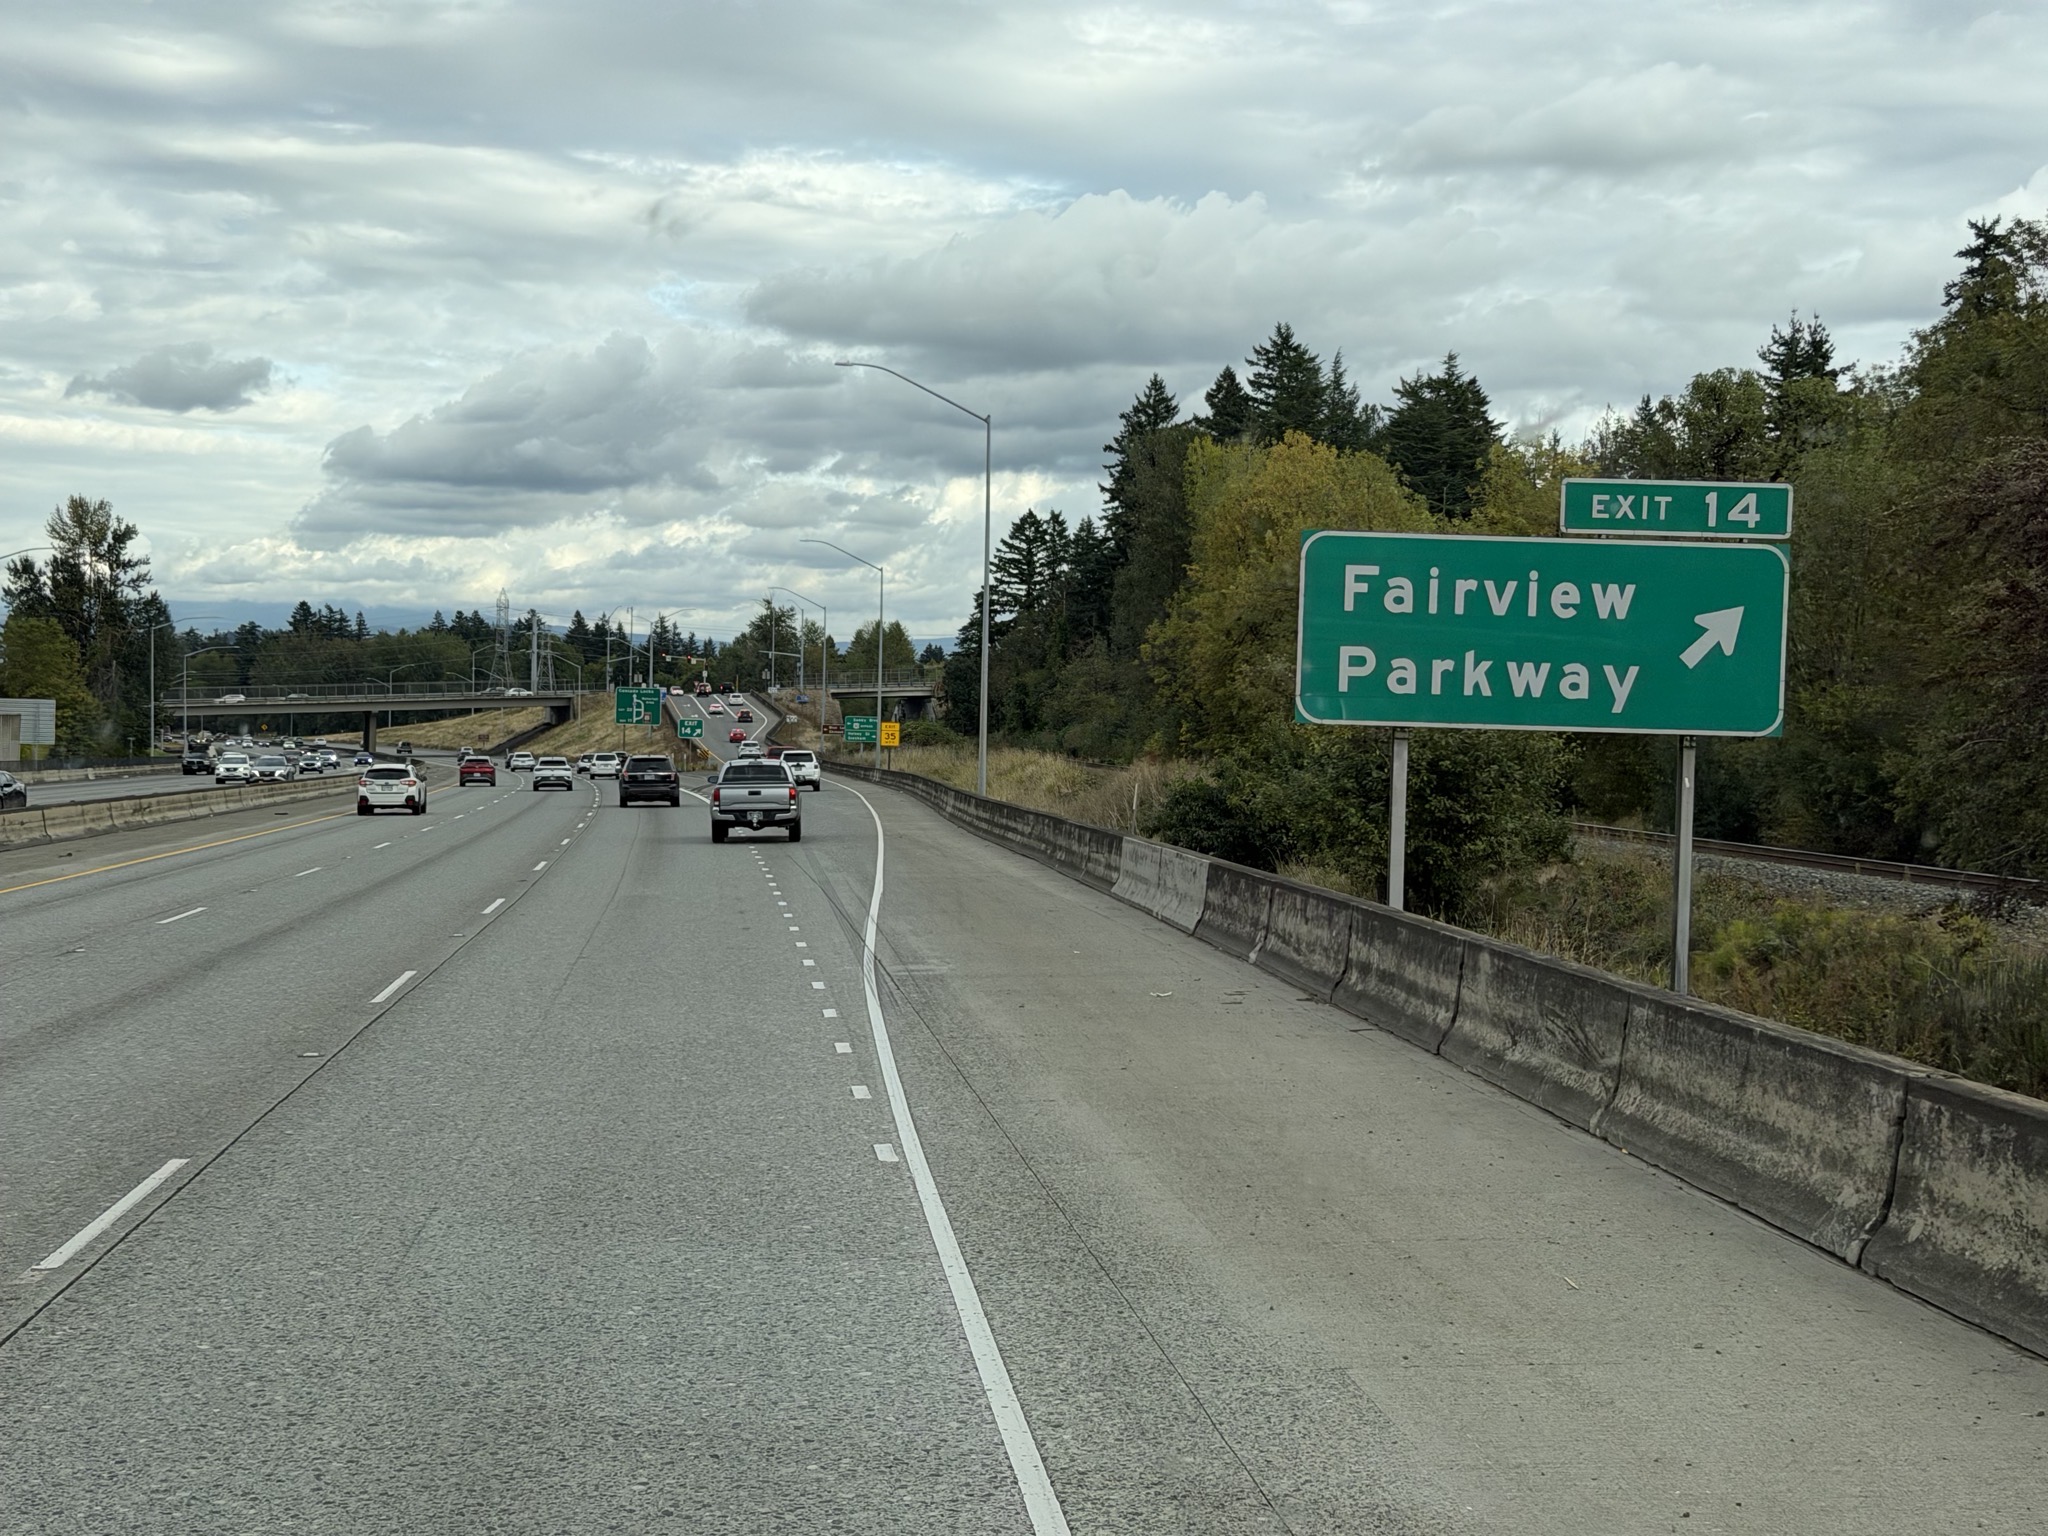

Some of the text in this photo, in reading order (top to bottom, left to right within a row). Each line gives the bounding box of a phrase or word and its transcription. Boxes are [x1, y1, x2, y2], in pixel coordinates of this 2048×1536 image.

[1591, 491, 1761, 528] EXIT 14
[1343, 564, 1637, 621] Fairview
[1337, 645, 1640, 714] Parkway
[885, 732, 896, 740] 35
